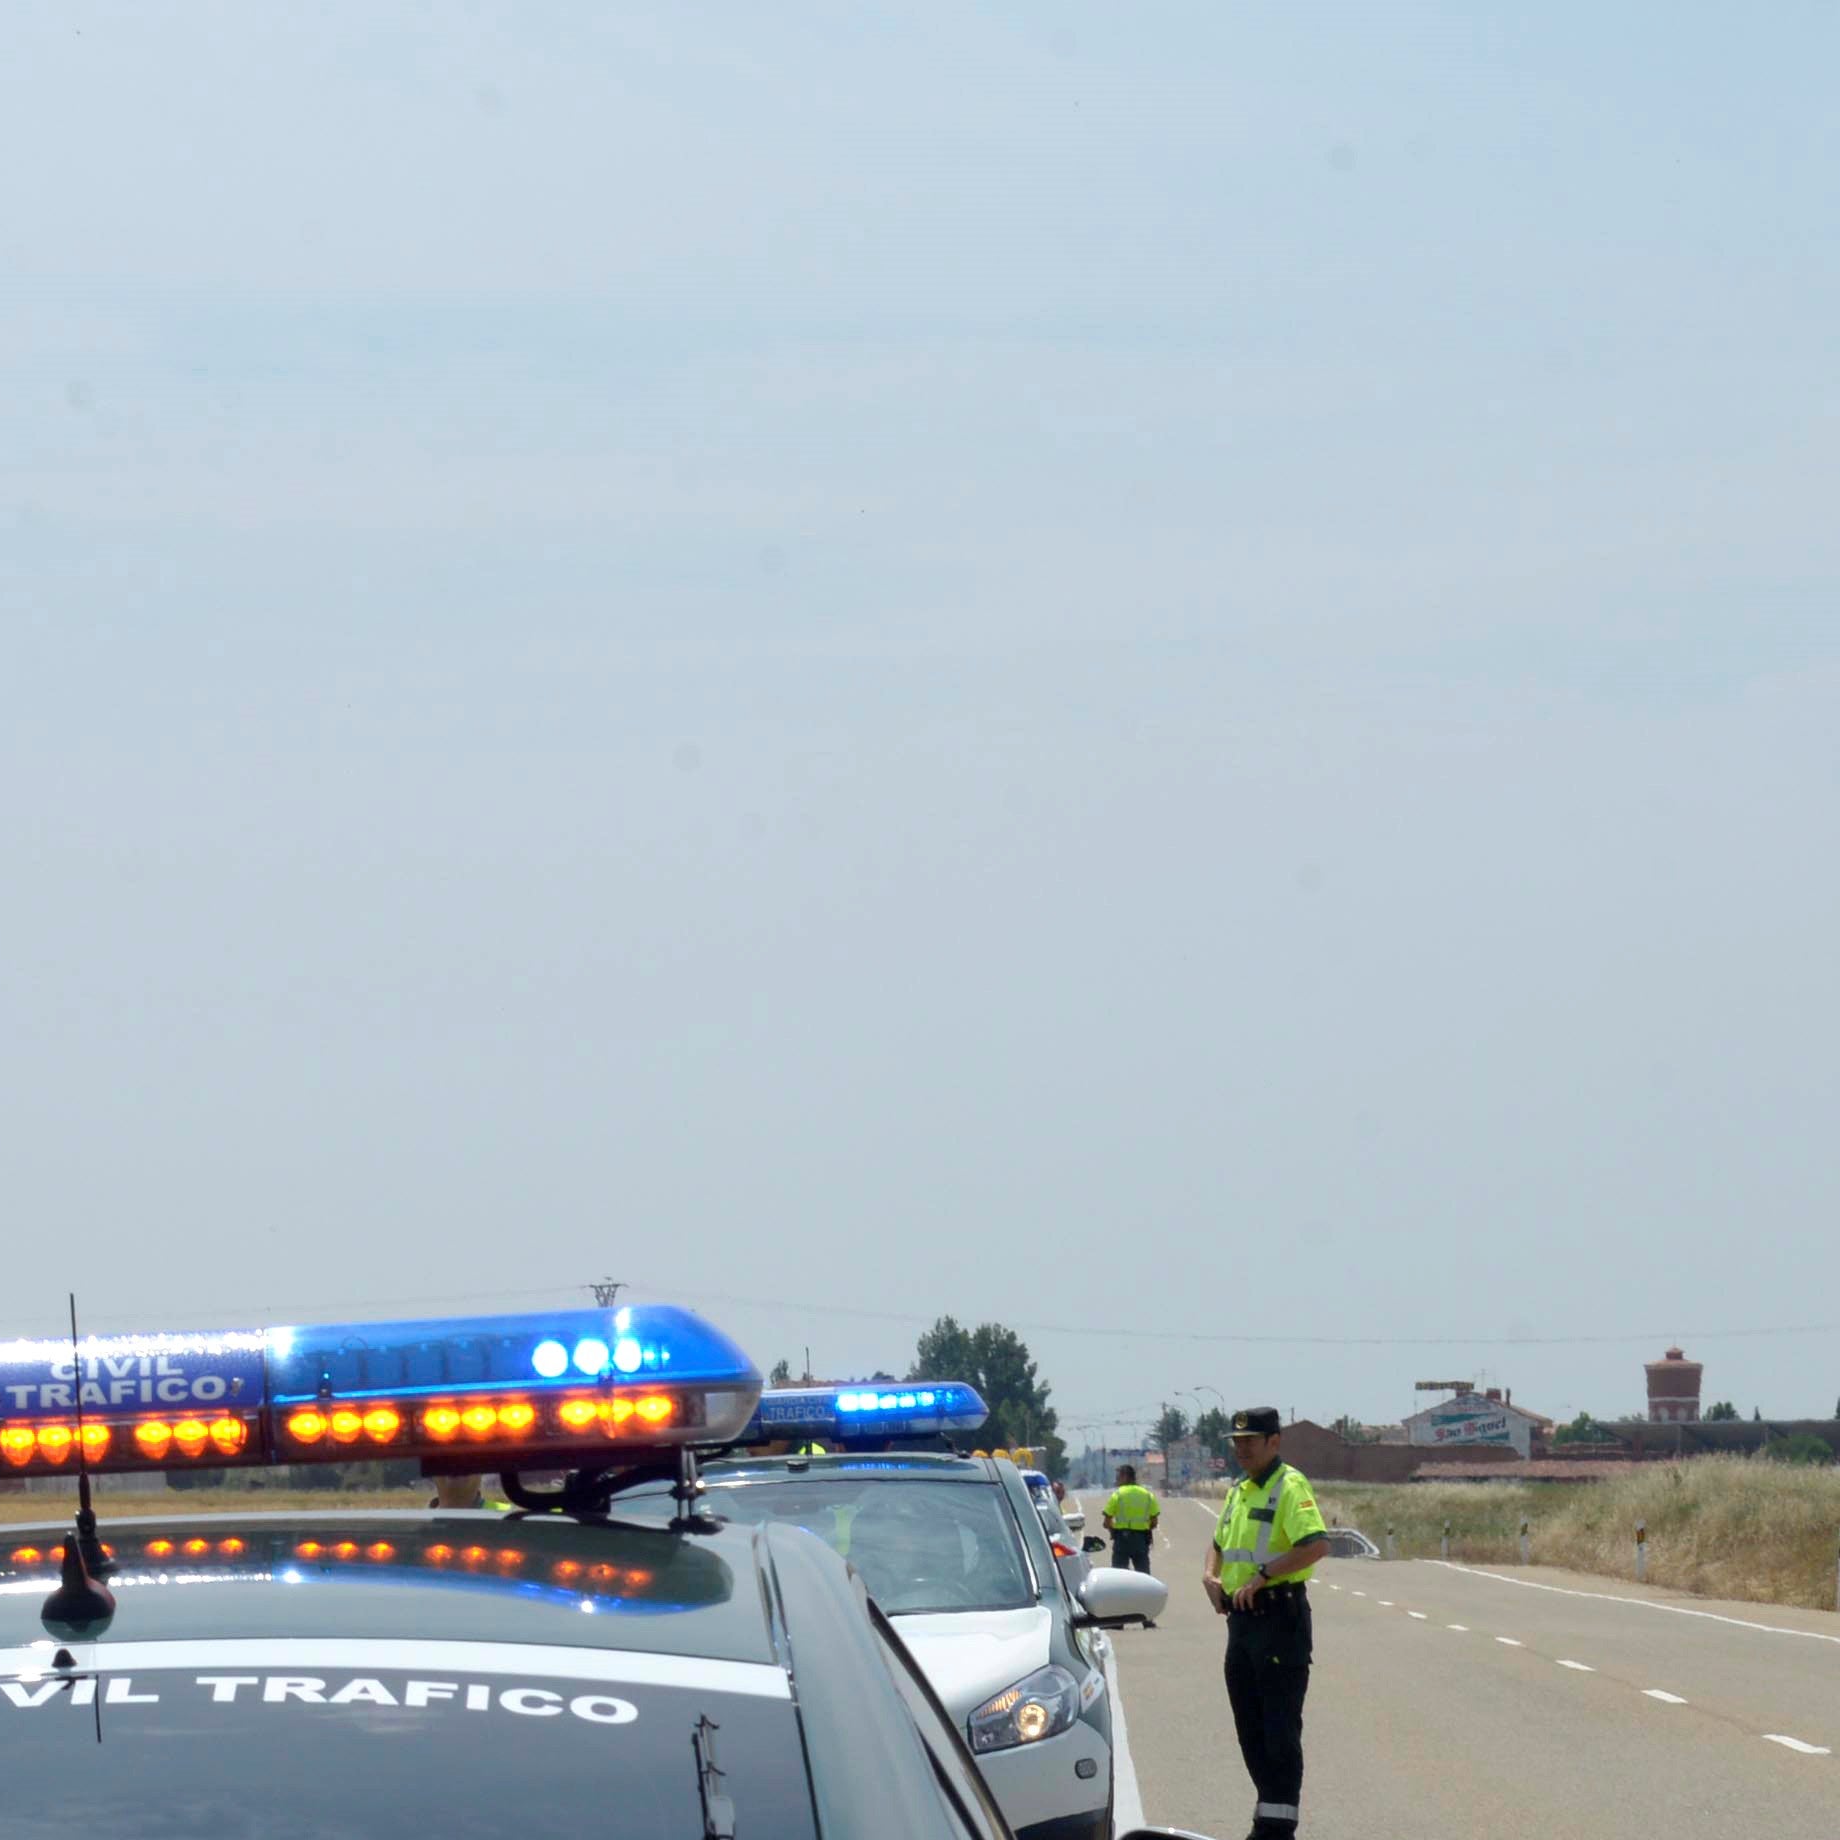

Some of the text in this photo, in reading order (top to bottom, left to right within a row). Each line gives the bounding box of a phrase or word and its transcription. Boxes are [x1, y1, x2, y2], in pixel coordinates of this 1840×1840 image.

[50, 1357, 183, 1381] CIVIL
[6, 1376, 226, 1409] TRAFICO
[196, 1676, 639, 1724] TRAFICO
